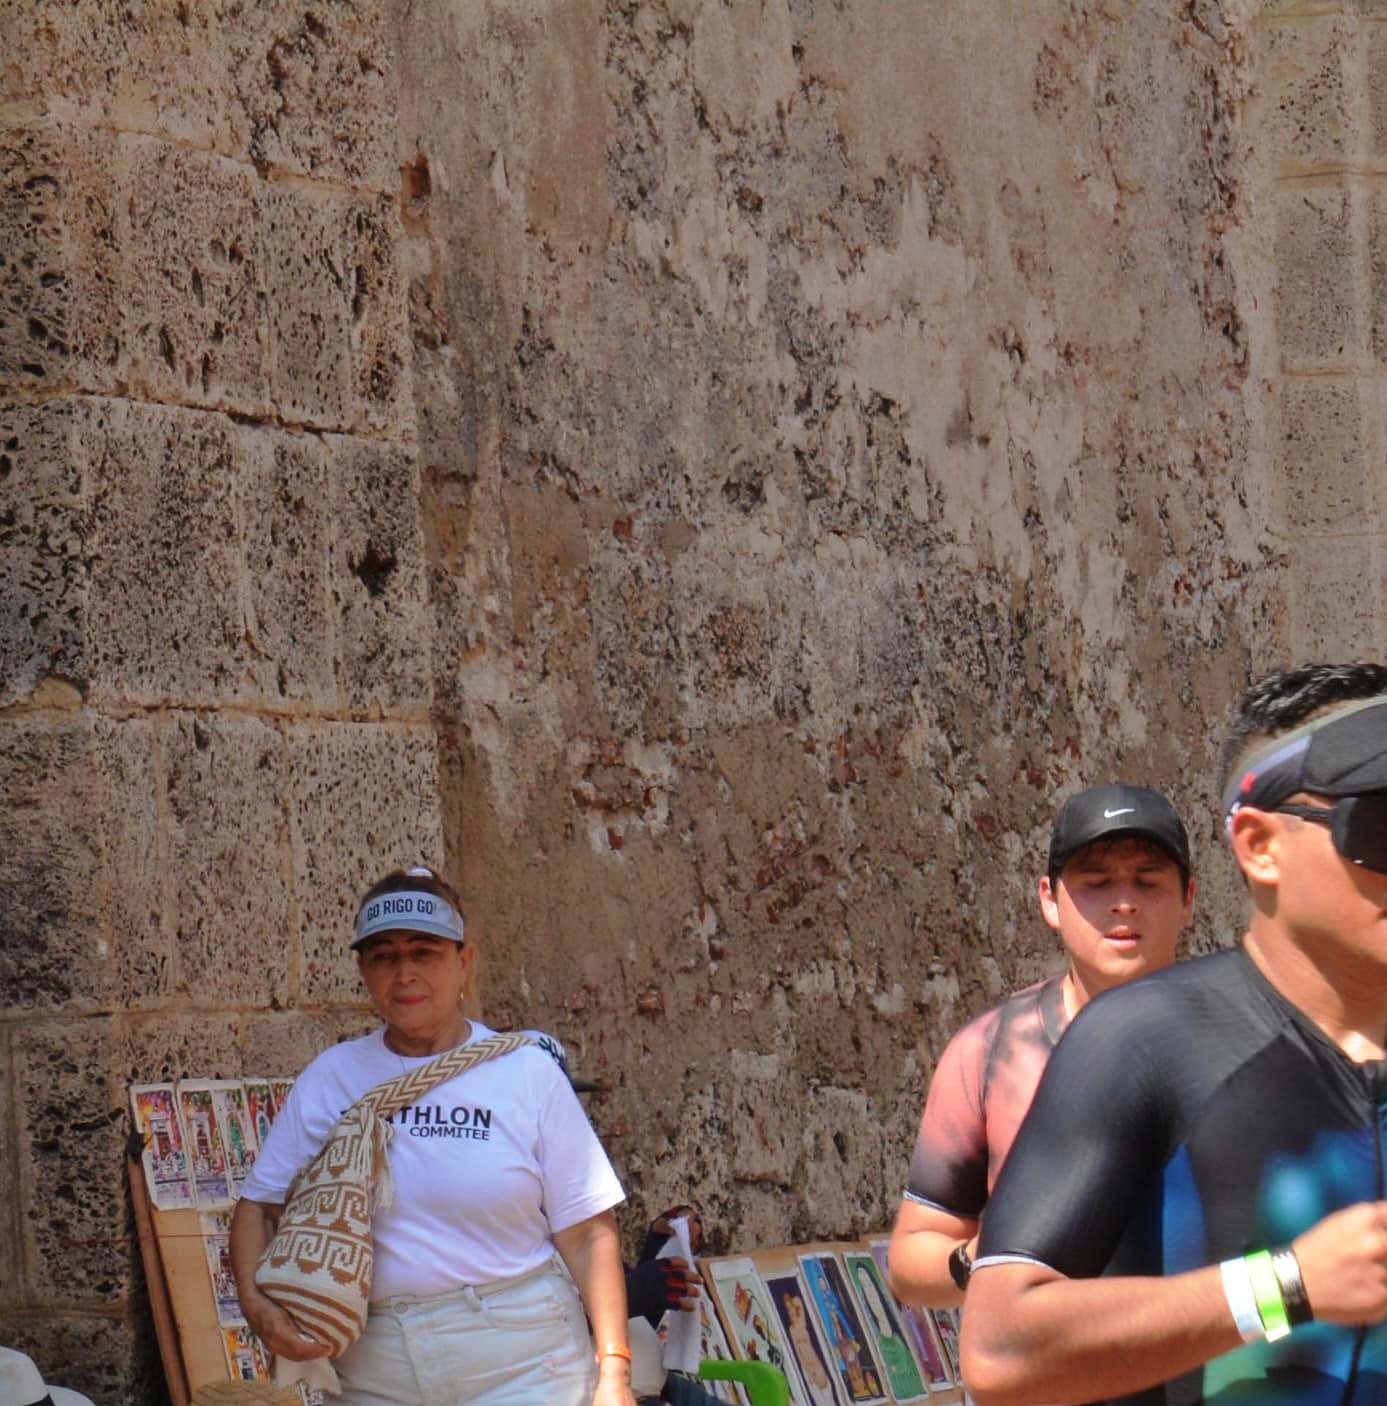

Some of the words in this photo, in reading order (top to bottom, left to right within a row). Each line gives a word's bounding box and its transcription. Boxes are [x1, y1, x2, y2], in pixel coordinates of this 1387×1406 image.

[367, 904, 381, 922] GO
[383, 898, 414, 915] RIGO
[409, 1124, 491, 1142] COMMITEE
